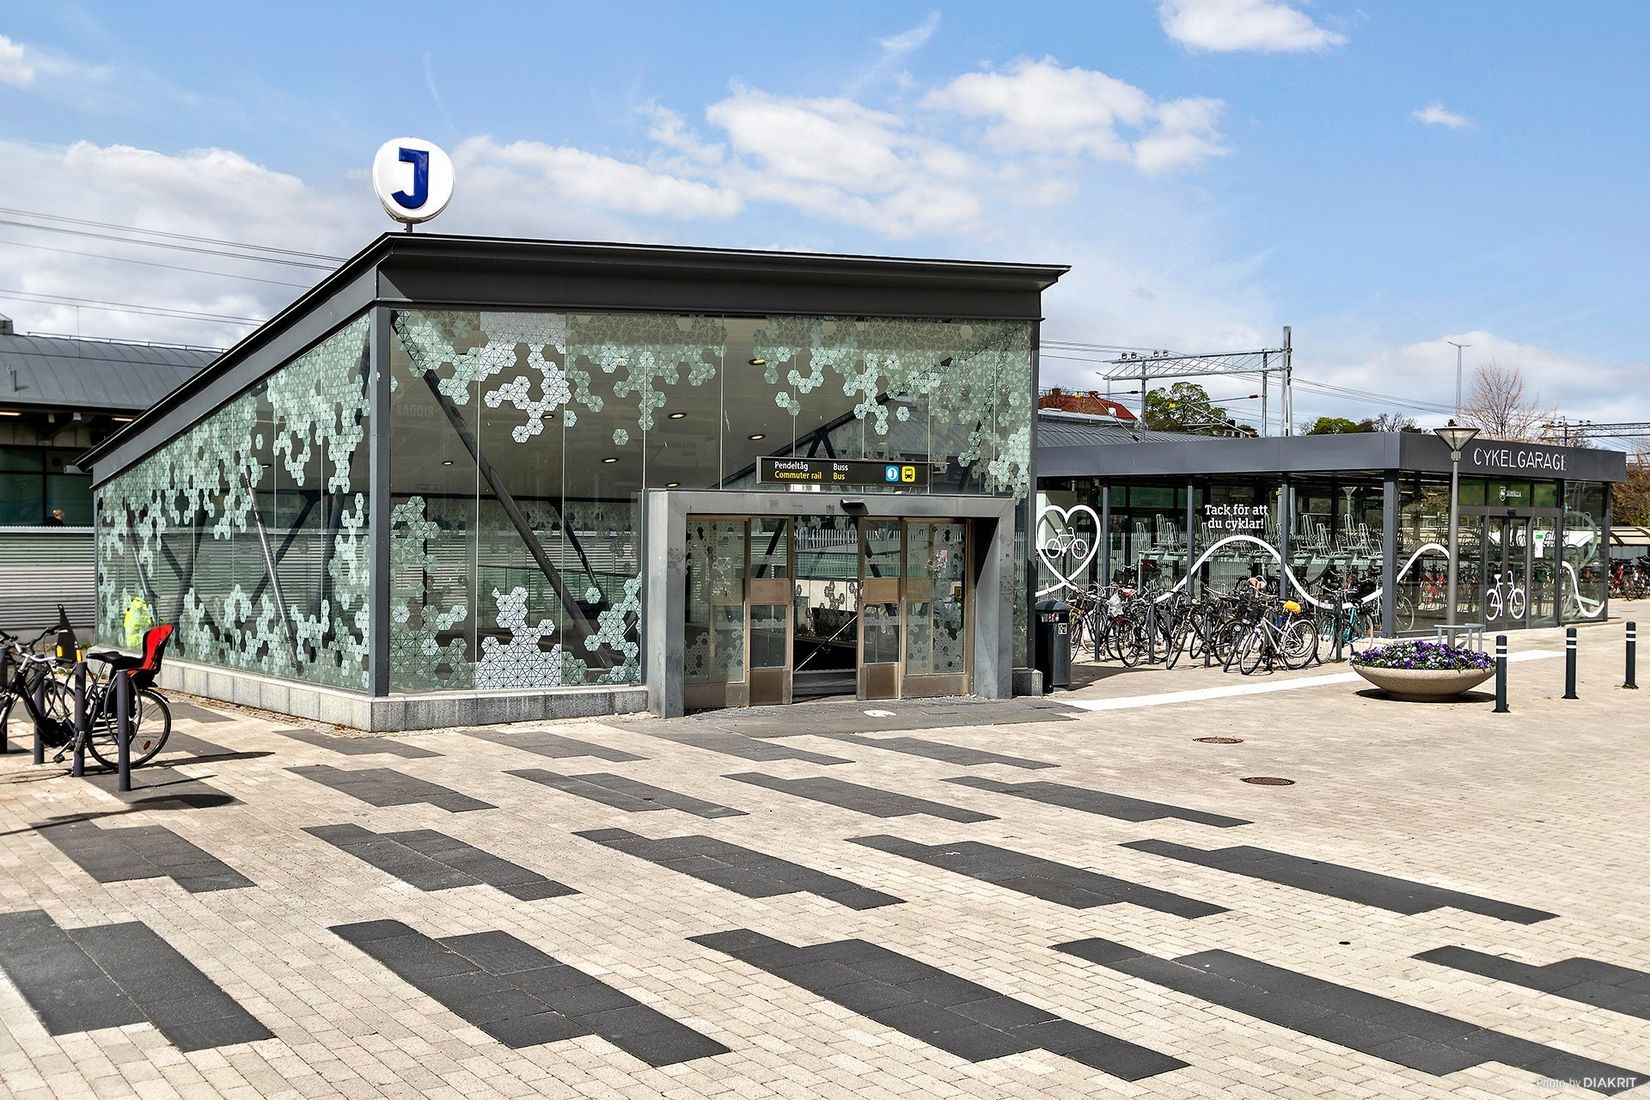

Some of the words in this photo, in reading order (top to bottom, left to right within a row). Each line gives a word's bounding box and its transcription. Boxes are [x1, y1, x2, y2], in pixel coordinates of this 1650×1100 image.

[391, 147, 429, 209] J
[1473, 447, 1567, 471] CYKELGARAGE
[774, 461, 809, 472] Pendeltåg
[833, 462, 849, 472] Buss
[774, 470, 809, 480] Commuter
[811, 471, 822, 480] rail
[833, 472, 846, 481] Bus
[1204, 504, 1231, 516] Tack
[1232, 503, 1250, 516] för
[1252, 504, 1268, 516] att
[1208, 517, 1223, 529] du
[1225, 517, 1264, 532] cyklar!
